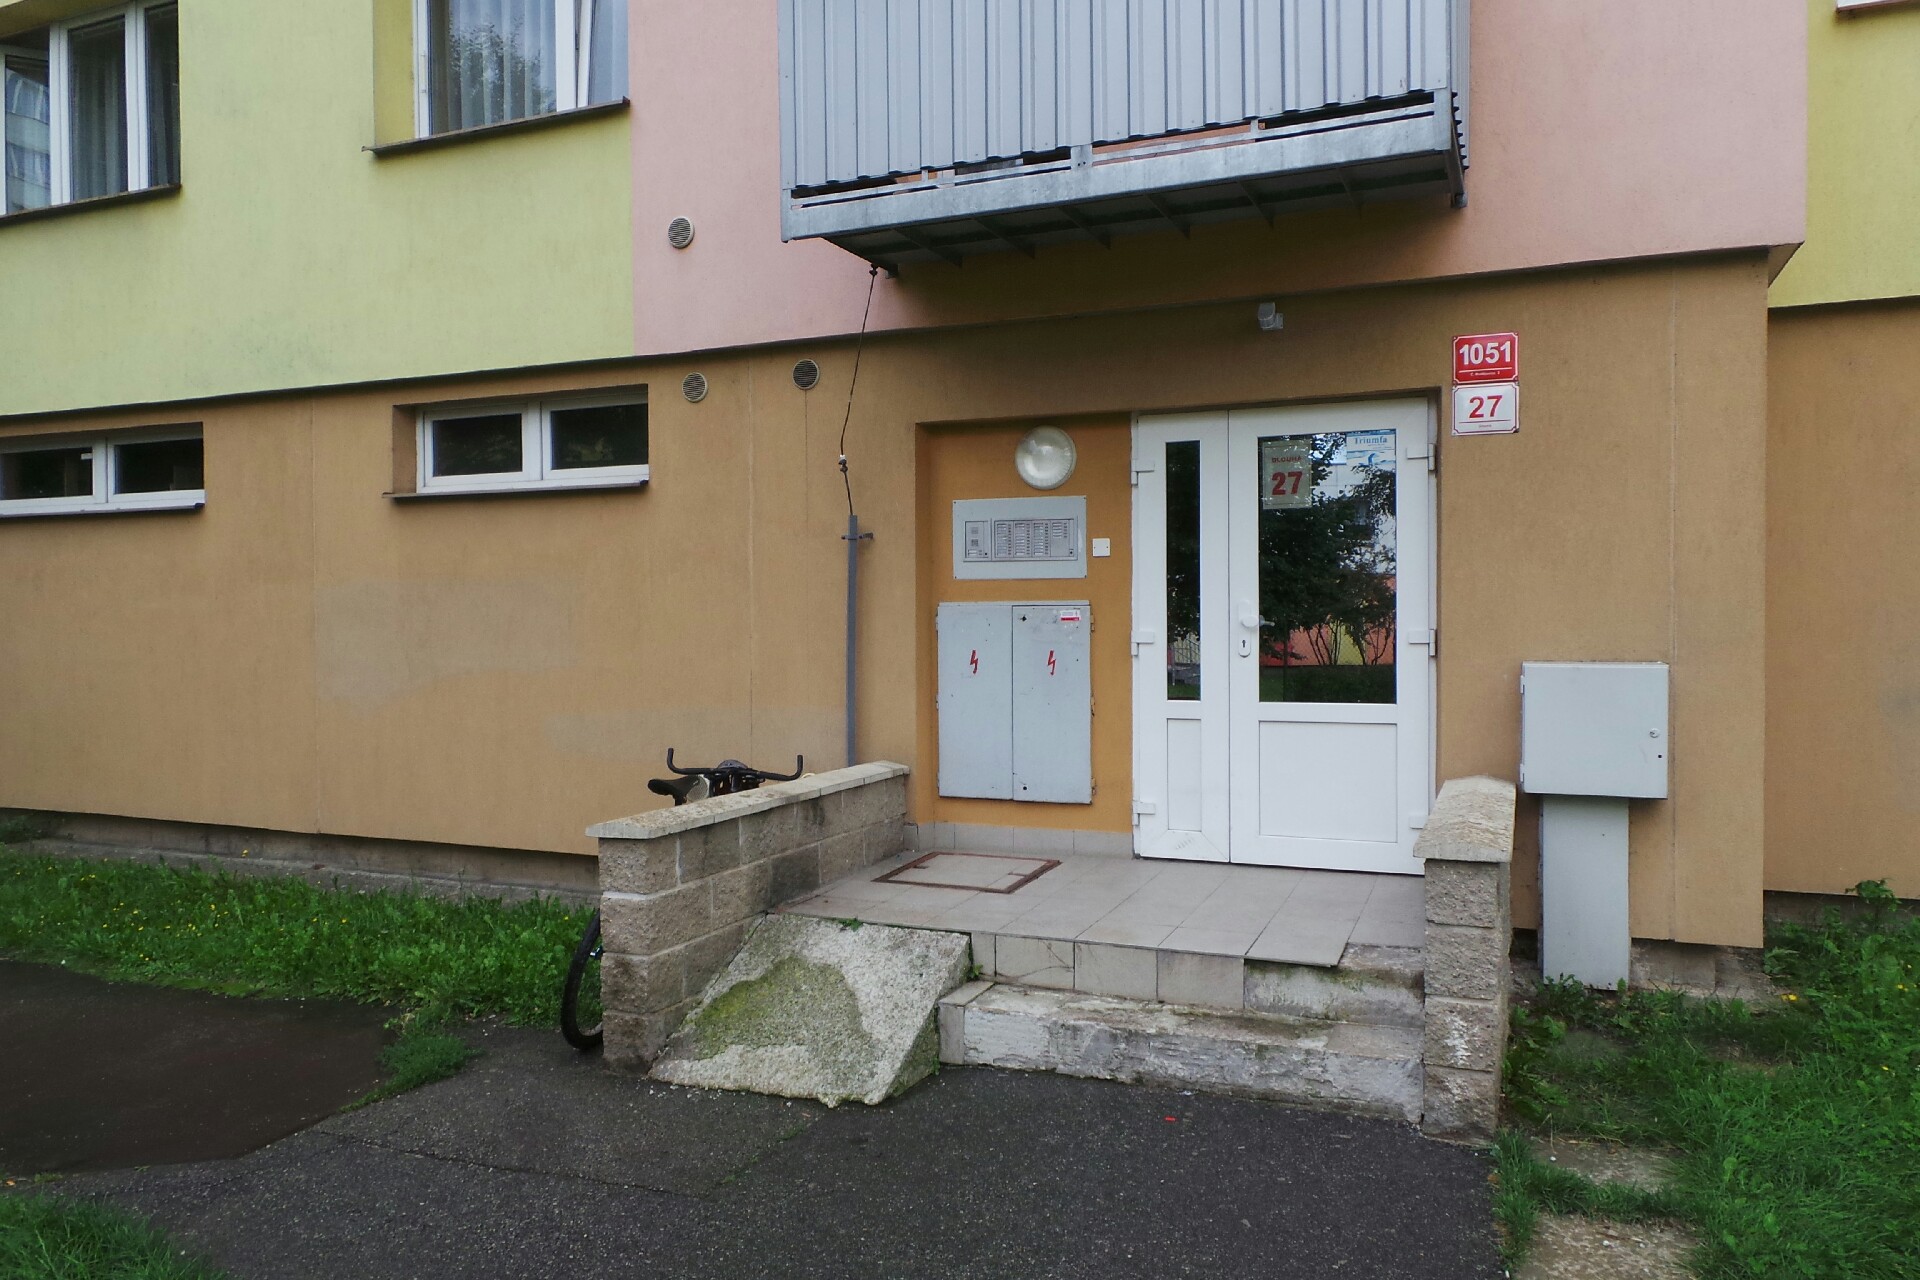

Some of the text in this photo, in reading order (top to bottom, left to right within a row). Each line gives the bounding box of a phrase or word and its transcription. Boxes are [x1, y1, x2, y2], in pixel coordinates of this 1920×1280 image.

[1459, 340, 1511, 365] 1051
[1469, 395, 1503, 418] 27
[1354, 435, 1387, 445] Triumfa
[1271, 471, 1303, 496] 27
